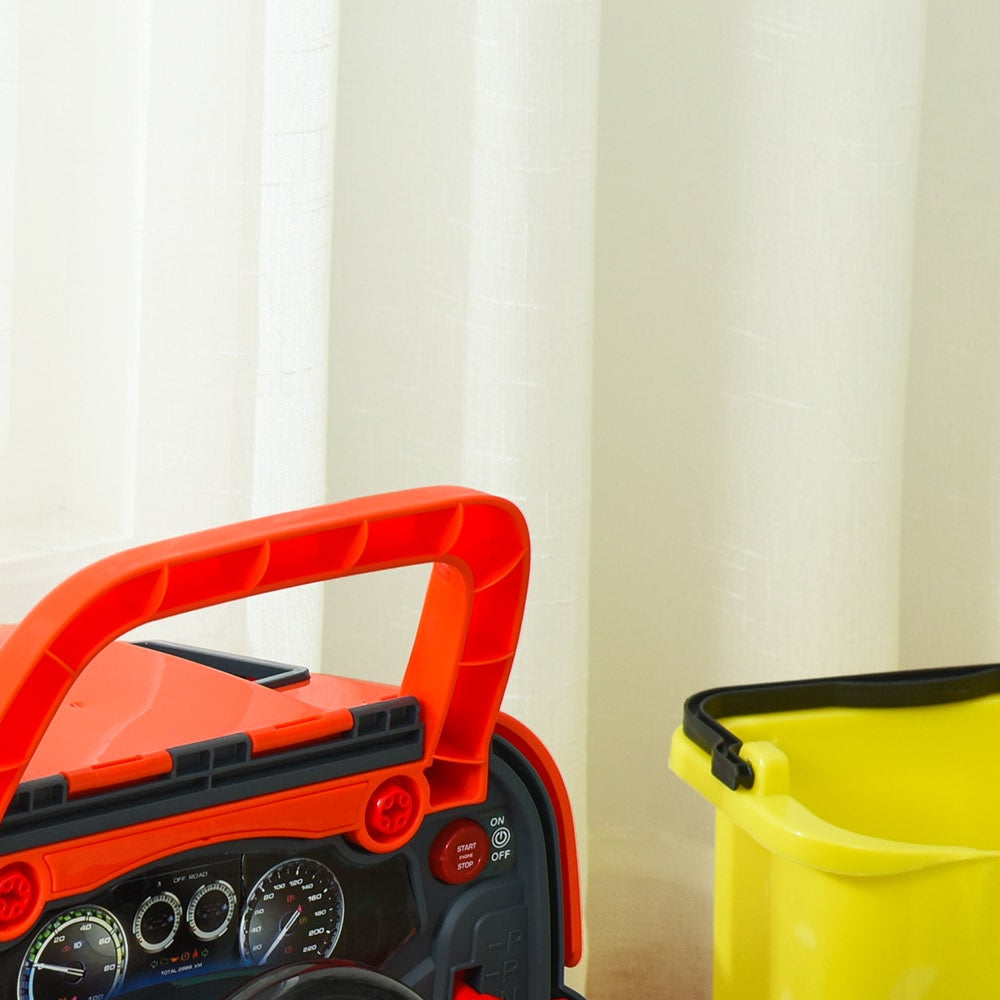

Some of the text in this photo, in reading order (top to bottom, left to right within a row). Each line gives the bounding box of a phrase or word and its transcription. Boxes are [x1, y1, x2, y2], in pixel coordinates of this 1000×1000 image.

[490, 816, 505, 827] ON
[457, 842, 477, 853] START
[491, 849, 511, 862] OFF
[457, 860, 474, 870] STOP
[188, 871, 208, 881] ROAD
[289, 878, 303, 886] 120
[263, 893, 275, 901] 80
[307, 893, 322, 902] 160
[254, 908, 264, 916] 60
[314, 909, 327, 917] 180
[80, 923, 92, 931] 40
[250, 925, 262, 933] 40
[308, 927, 325, 937] 200
[53, 935, 65, 943] 20
[98, 936, 111, 945] 60
[506, 929, 523, 954] P
[302, 944, 317, 953] 220
[103, 963, 115, 972] 80
[160, 967, 177, 976] TOTAL
[502, 960, 518, 983] R
